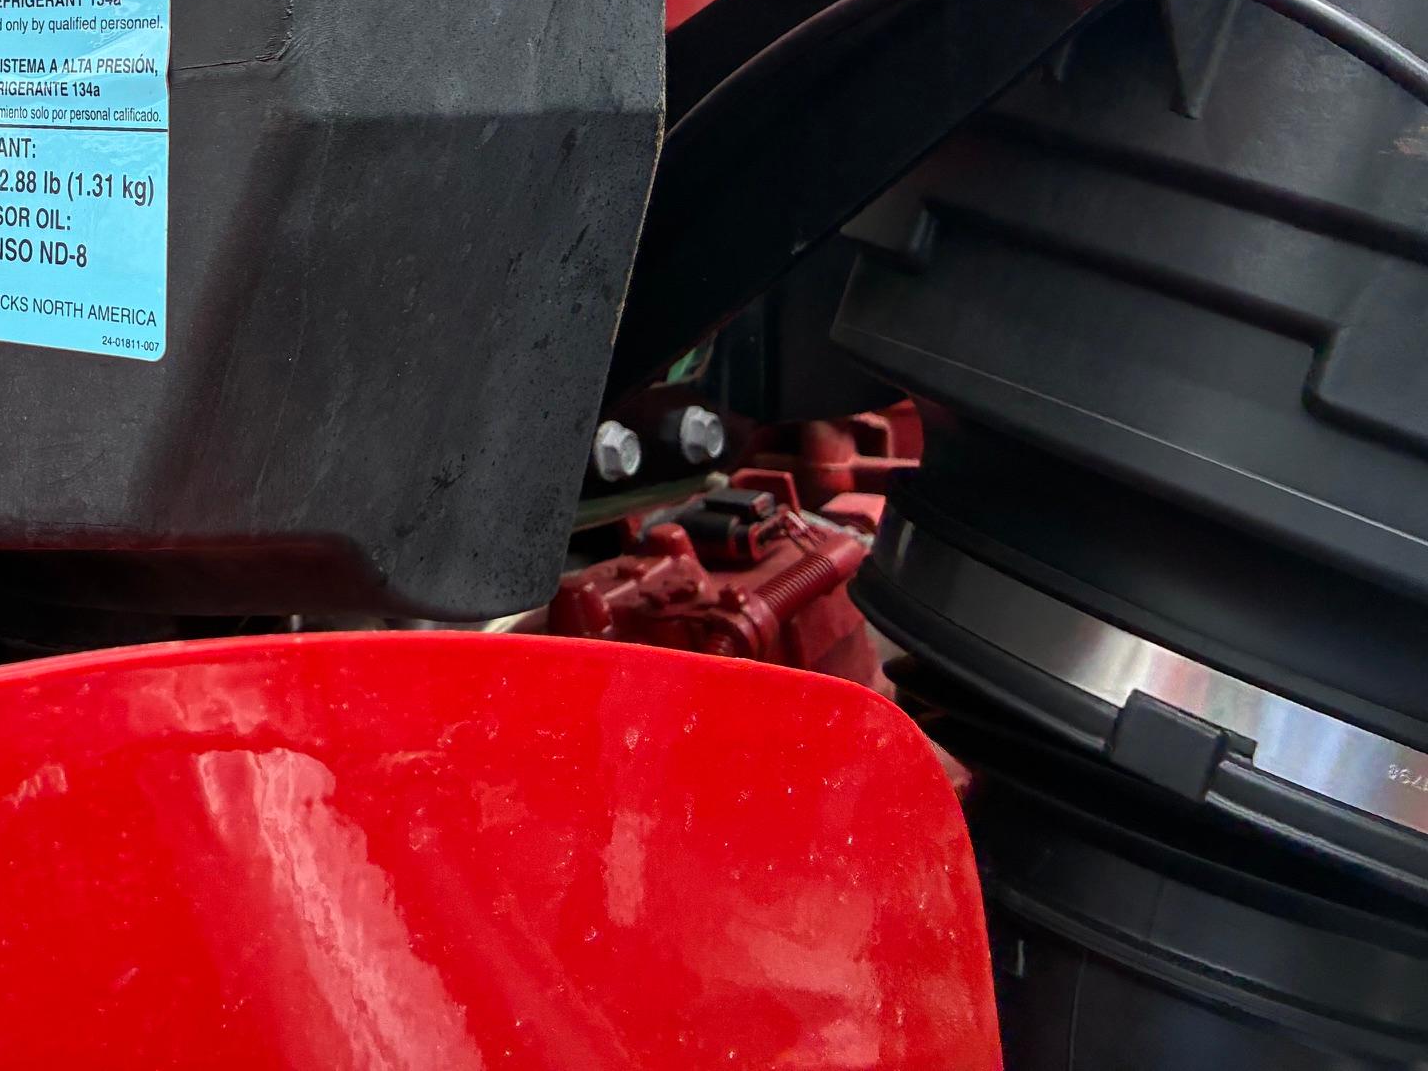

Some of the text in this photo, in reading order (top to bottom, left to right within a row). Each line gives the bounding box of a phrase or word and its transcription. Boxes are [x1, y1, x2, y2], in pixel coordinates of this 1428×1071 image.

[6, 18, 28, 34] only
[32, 18, 44, 34] by
[49, 16, 96, 37] qualified
[101, 16, 163, 36] personnel.
[49, 59, 57, 73] A
[62, 59, 92, 73] ALTA
[97, 55, 158, 76] PRESIÓN,
[73, 82, 100, 96] 134a
[31, 106, 49, 119] solo
[52, 109, 67, 122] por
[71, 107, 110, 123] personal
[114, 107, 161, 122] calificado.
[44, 171, 60, 194] lb
[68, 172, 113, 201] (1.31
[123, 174, 154, 206] kg)
[36, 208, 71, 230] OIL:
[40, 241, 87, 267] ND-8
[33, 298, 83, 318] NORTH
[88, 305, 156, 326] AMERICA
[102, 336, 159, 352] 24-01811-007
